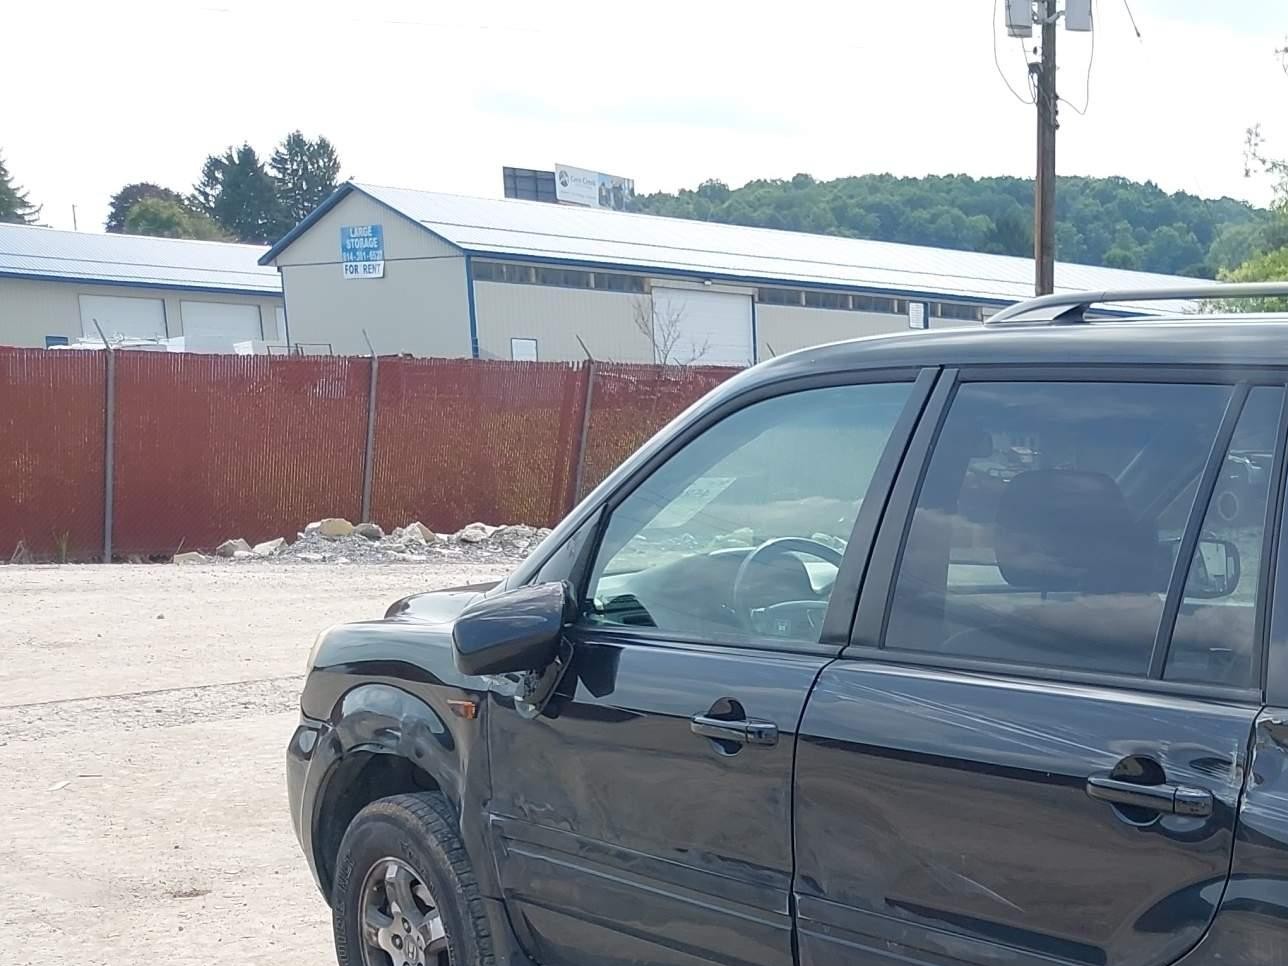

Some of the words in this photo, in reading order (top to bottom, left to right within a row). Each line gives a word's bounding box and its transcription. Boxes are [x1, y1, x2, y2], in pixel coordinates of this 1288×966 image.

[350, 226, 373, 238] LARGE
[345, 237, 379, 249] STORAGE
[344, 264, 360, 275] FOR
[362, 263, 381, 274] RENT
